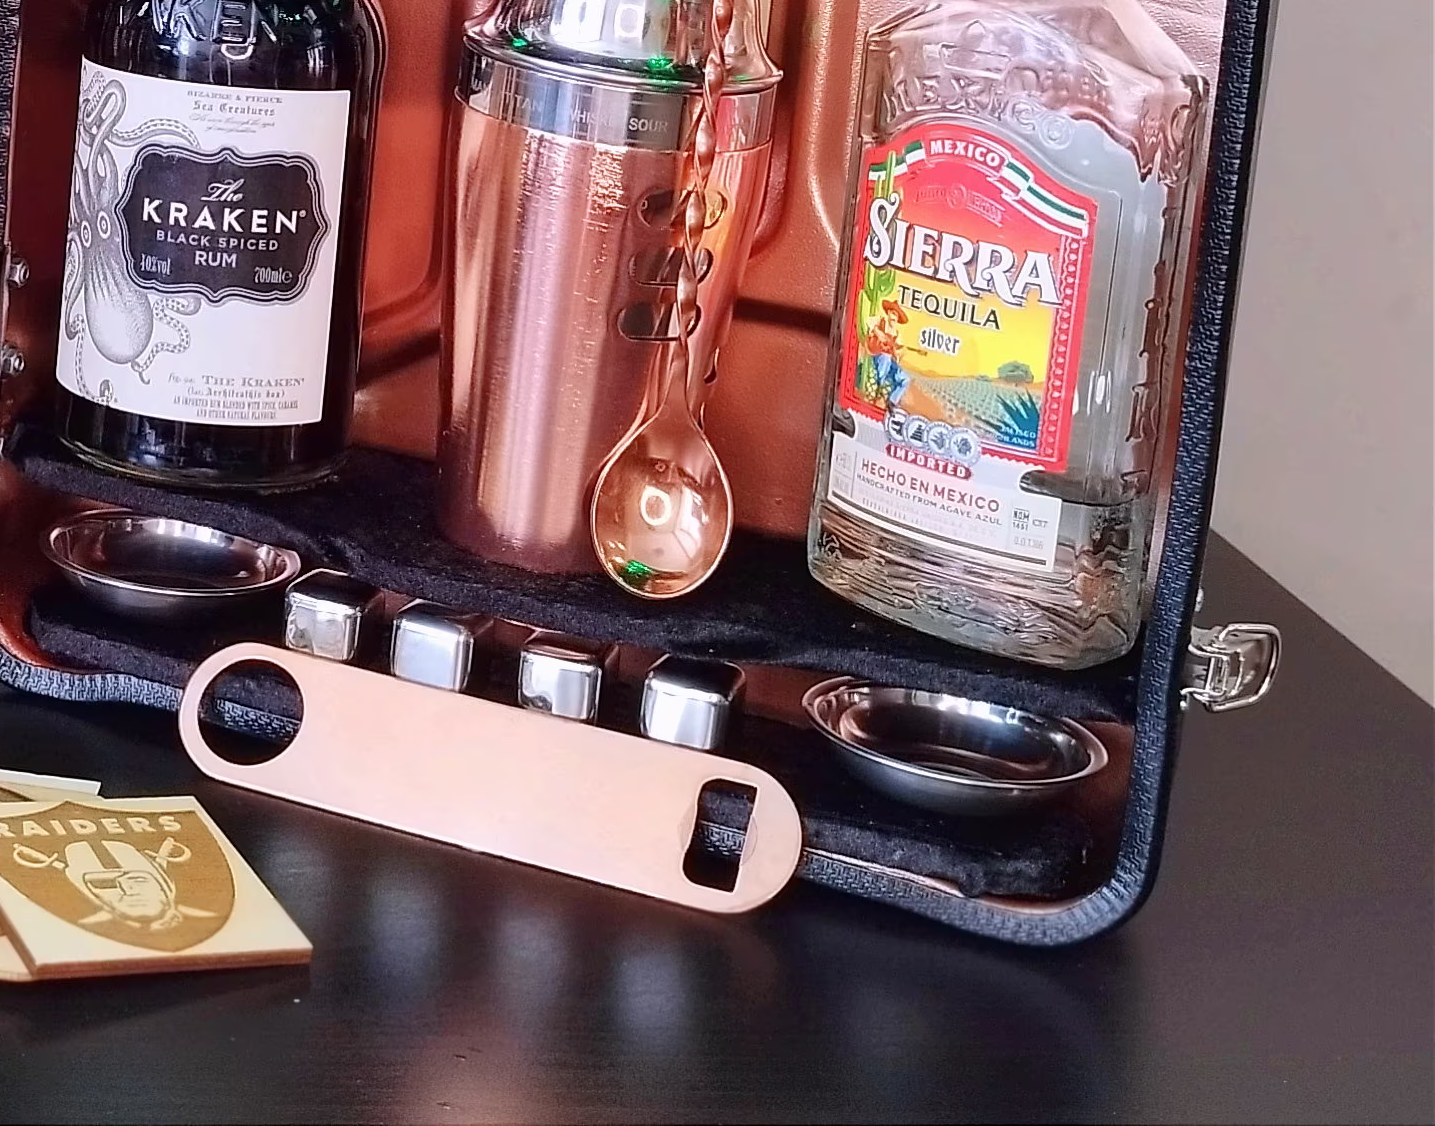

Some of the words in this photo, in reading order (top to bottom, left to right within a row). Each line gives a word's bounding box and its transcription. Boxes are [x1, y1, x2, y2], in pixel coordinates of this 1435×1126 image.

[219, 102, 276, 116] Creatures
[628, 117, 668, 133] SOUR
[930, 139, 1001, 168] MEXICO
[201, 178, 246, 203] The
[142, 197, 298, 234] KRAKEN
[156, 229, 210, 248] BLACK
[218, 237, 279, 252] SPICED
[864, 191, 1063, 307] SIERRA
[194, 250, 238, 269] RUM
[898, 284, 1000, 331] TEQUILA
[920, 327, 960, 355] silver
[890, 444, 966, 479] IMPORTED
[856, 473, 912, 501] HANDCRAFTED
[912, 494, 939, 509] FROM
[939, 503, 972, 519] AGAVE
[975, 513, 1003, 526] AZUL
[861, 457, 907, 487] HECHO
[910, 477, 930, 495] EN
[932, 483, 1000, 513] MEXICO
